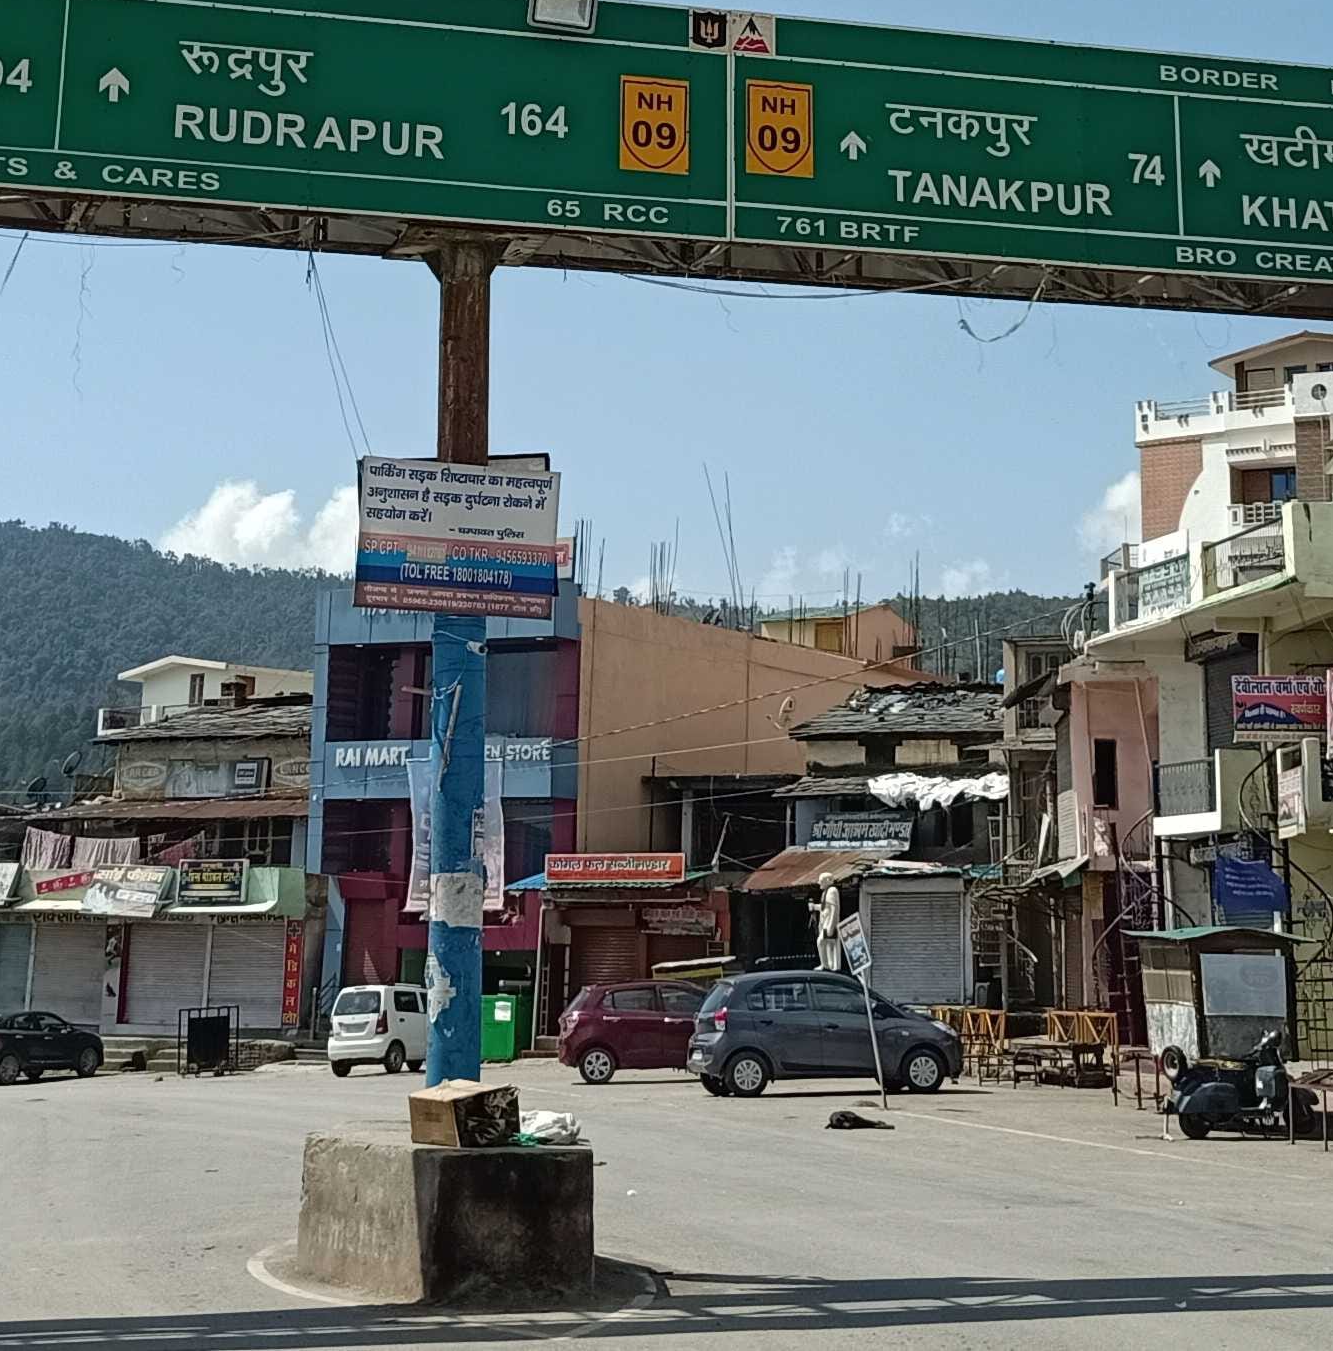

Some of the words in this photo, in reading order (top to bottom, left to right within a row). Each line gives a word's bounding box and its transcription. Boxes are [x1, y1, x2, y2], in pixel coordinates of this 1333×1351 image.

[1159, 64, 1279, 91] BORDER
[636, 90, 674, 114] NH
[760, 94, 797, 117] NH
[173, 103, 445, 160] RUDRAPUR
[500, 101, 570, 139] 164
[630, 119, 678, 151] 09
[756, 123, 802, 155] 09
[884, 102, 1039, 158] टनकपुर
[53, 160, 78, 180] &
[101, 164, 221, 192] CARES
[887, 168, 1113, 217] TANAKPUR
[1127, 152, 1166, 187] 74
[546, 198, 582, 219] 65
[603, 202, 669, 225] RCC
[776, 215, 826, 237] 761
[839, 220, 920, 244] BRTF
[1175, 245, 1237, 267] BRO
[369, 462, 407, 481] पार्किंग
[408, 468, 439, 484] सड़क
[440, 467, 487, 485] शिष्टाचार
[488, 474, 504, 487] का
[505, 474, 554, 494] महत्वपूर्ण
[366, 486, 421, 504] अनुशासन
[422, 487, 432, 503] है
[433, 493, 463, 507] सड़क
[464, 492, 501, 511] दुर्घटना
[503, 494, 534, 510] रोकने
[535, 495, 548, 511] में
[365, 505, 407, 521] सहयोग
[457, 526, 495, 538] चम्पावत
[496, 527, 526, 540] पुलिस
[364, 539, 378, 554] SP
[379, 540, 399, 555] CPT
[452, 546, 467, 561] CO
[468, 547, 489, 563] TKR
[399, 562, 422, 581] (TOL
[423, 564, 450, 581] FREE
[1233, 675, 1272, 695] देवीलाल
[1274, 675, 1293, 695] वर्मा
[335, 747, 361, 768] RAI
[364, 745, 410, 767] MART
[506, 739, 552, 762] STORE
